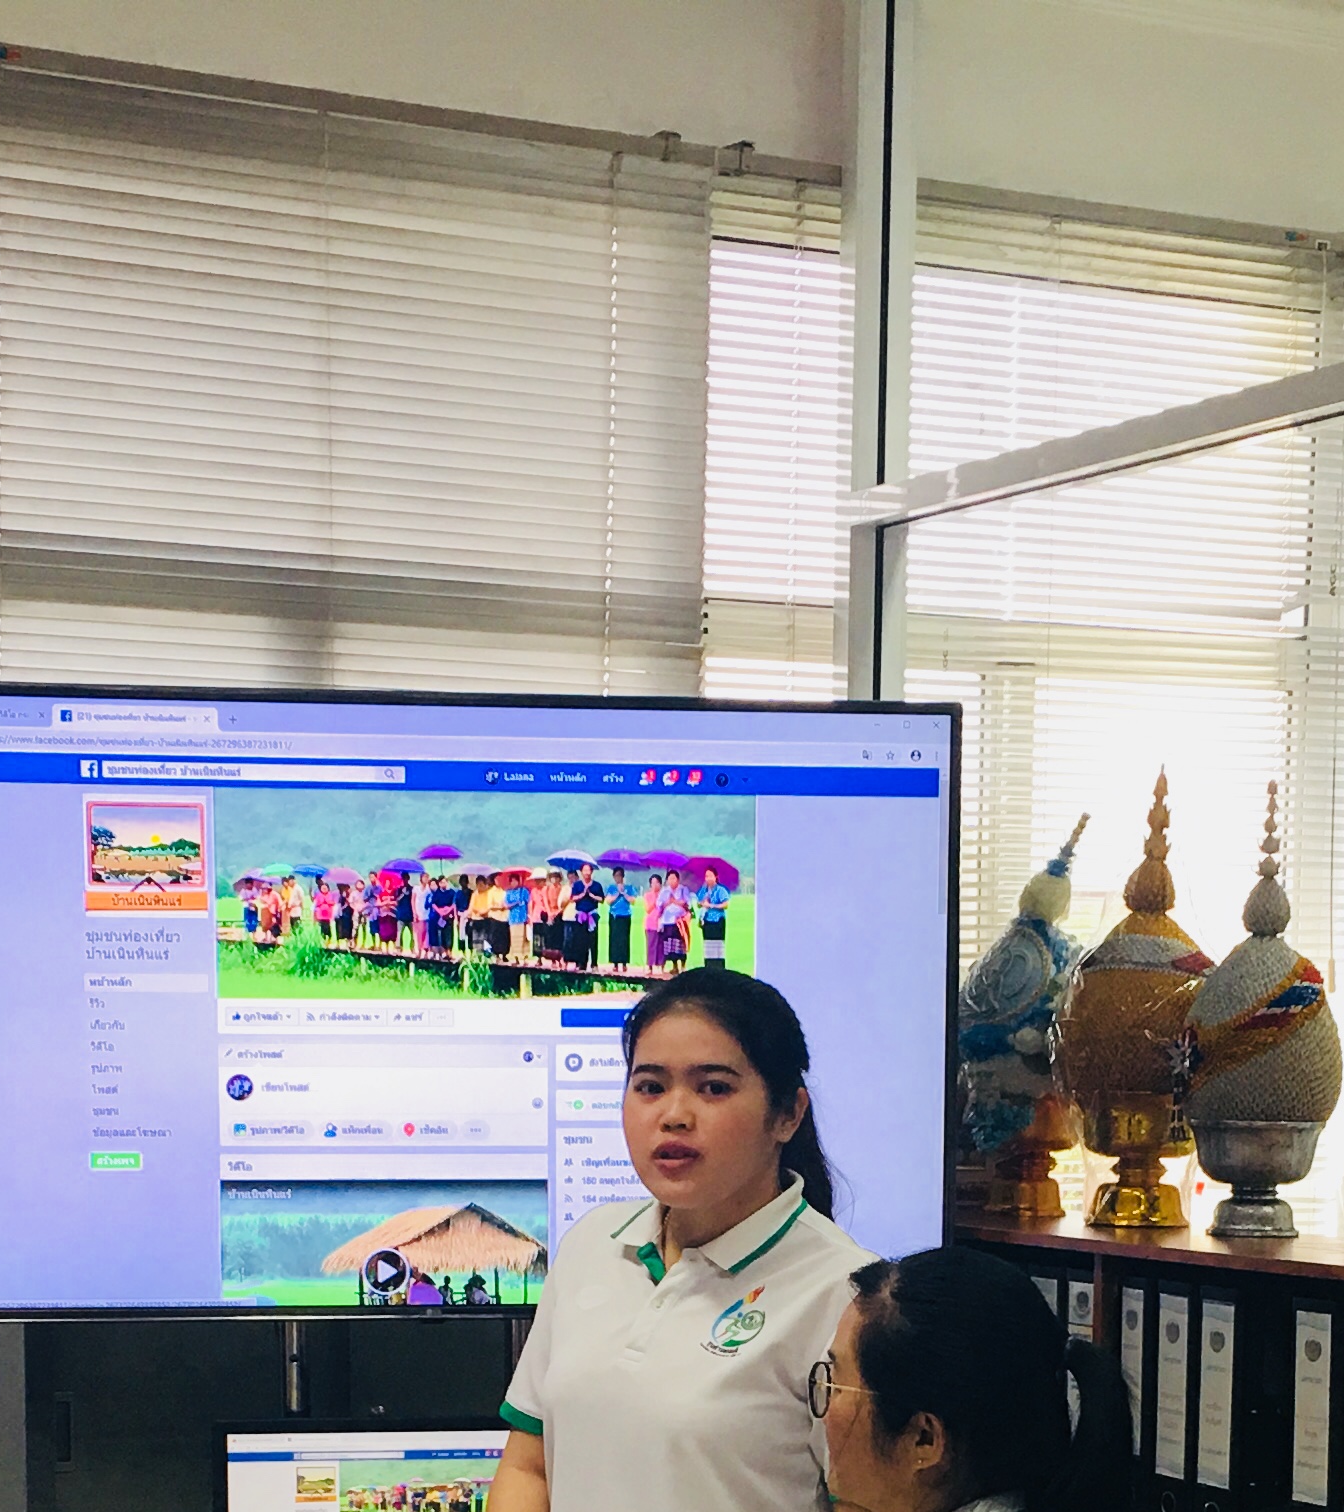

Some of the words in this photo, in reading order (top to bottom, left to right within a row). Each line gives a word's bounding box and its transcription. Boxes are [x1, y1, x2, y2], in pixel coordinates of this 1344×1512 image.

[111, 892, 182, 907] บ้านเนินหินแร่
[85, 927, 181, 944] ชุมชนท่องเที่ยว
[85, 946, 170, 961] บ้านเนินหินแร่
[89, 976, 132, 988] หน้าหลัก
